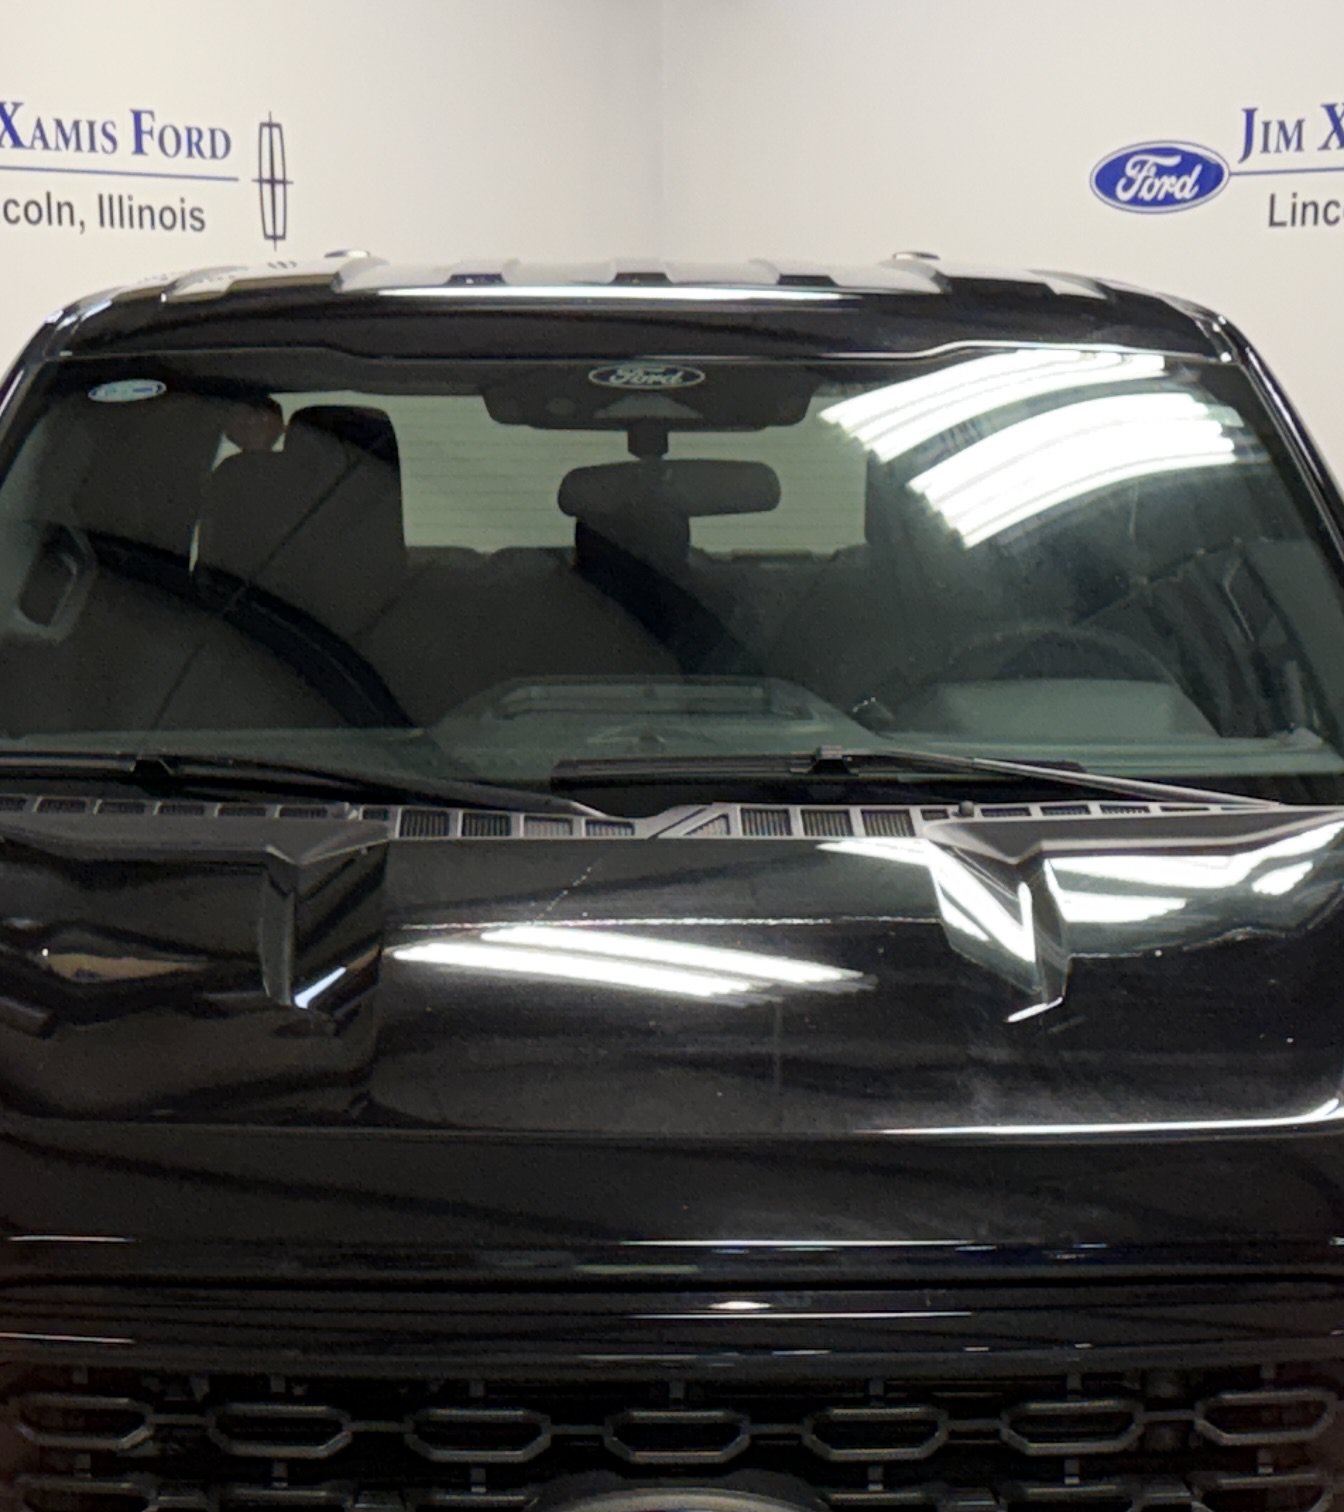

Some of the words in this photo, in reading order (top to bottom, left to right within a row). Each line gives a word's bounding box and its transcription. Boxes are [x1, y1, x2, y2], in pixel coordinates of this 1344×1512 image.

[130, 109, 232, 160] FORD
[1239, 107, 1305, 163] JIM
[1115, 152, 1202, 201] Ford
[97, 193, 206, 233] Illinois
[609, 365, 684, 384] Ford
